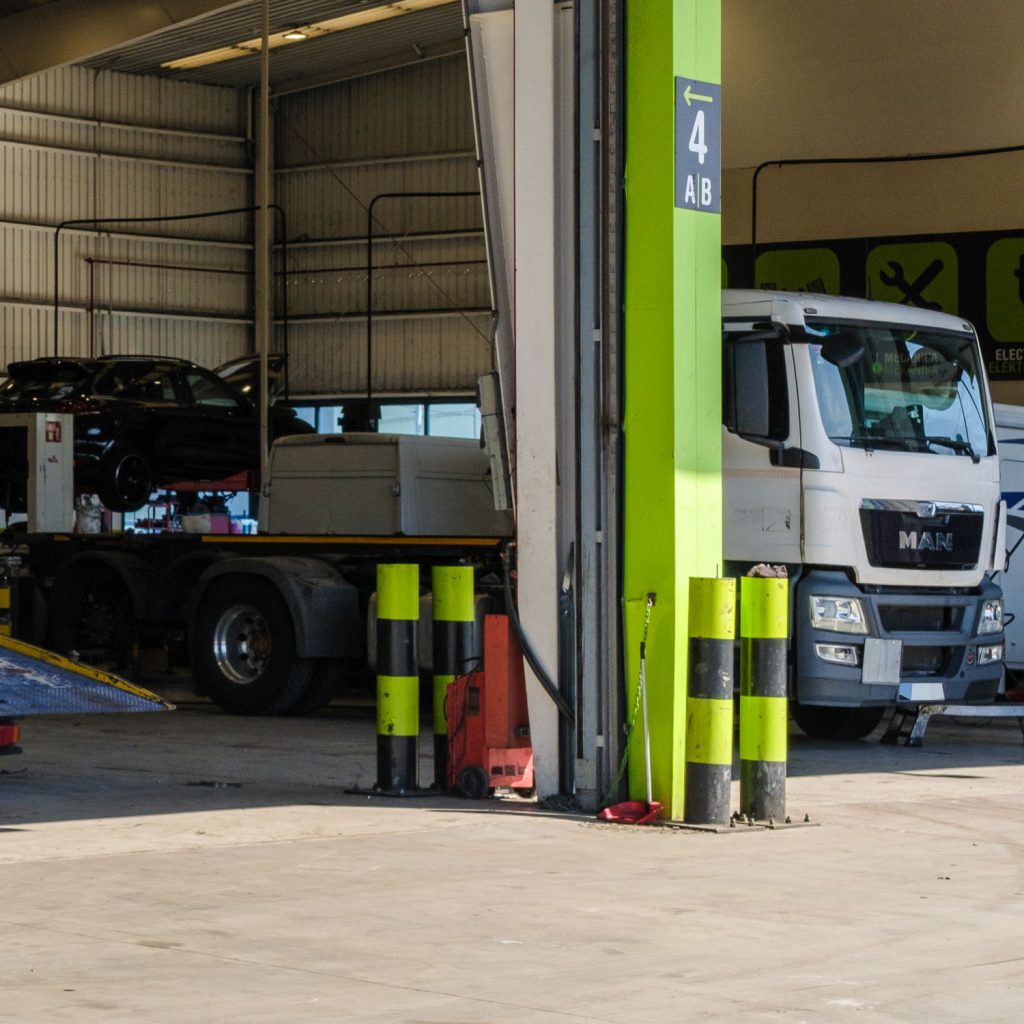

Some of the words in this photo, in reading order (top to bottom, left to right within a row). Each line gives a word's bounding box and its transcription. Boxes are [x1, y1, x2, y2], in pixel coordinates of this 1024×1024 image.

[688, 110, 708, 165] 4
[995, 348, 1024, 361] ELEC
[899, 531, 953, 551] MAN
